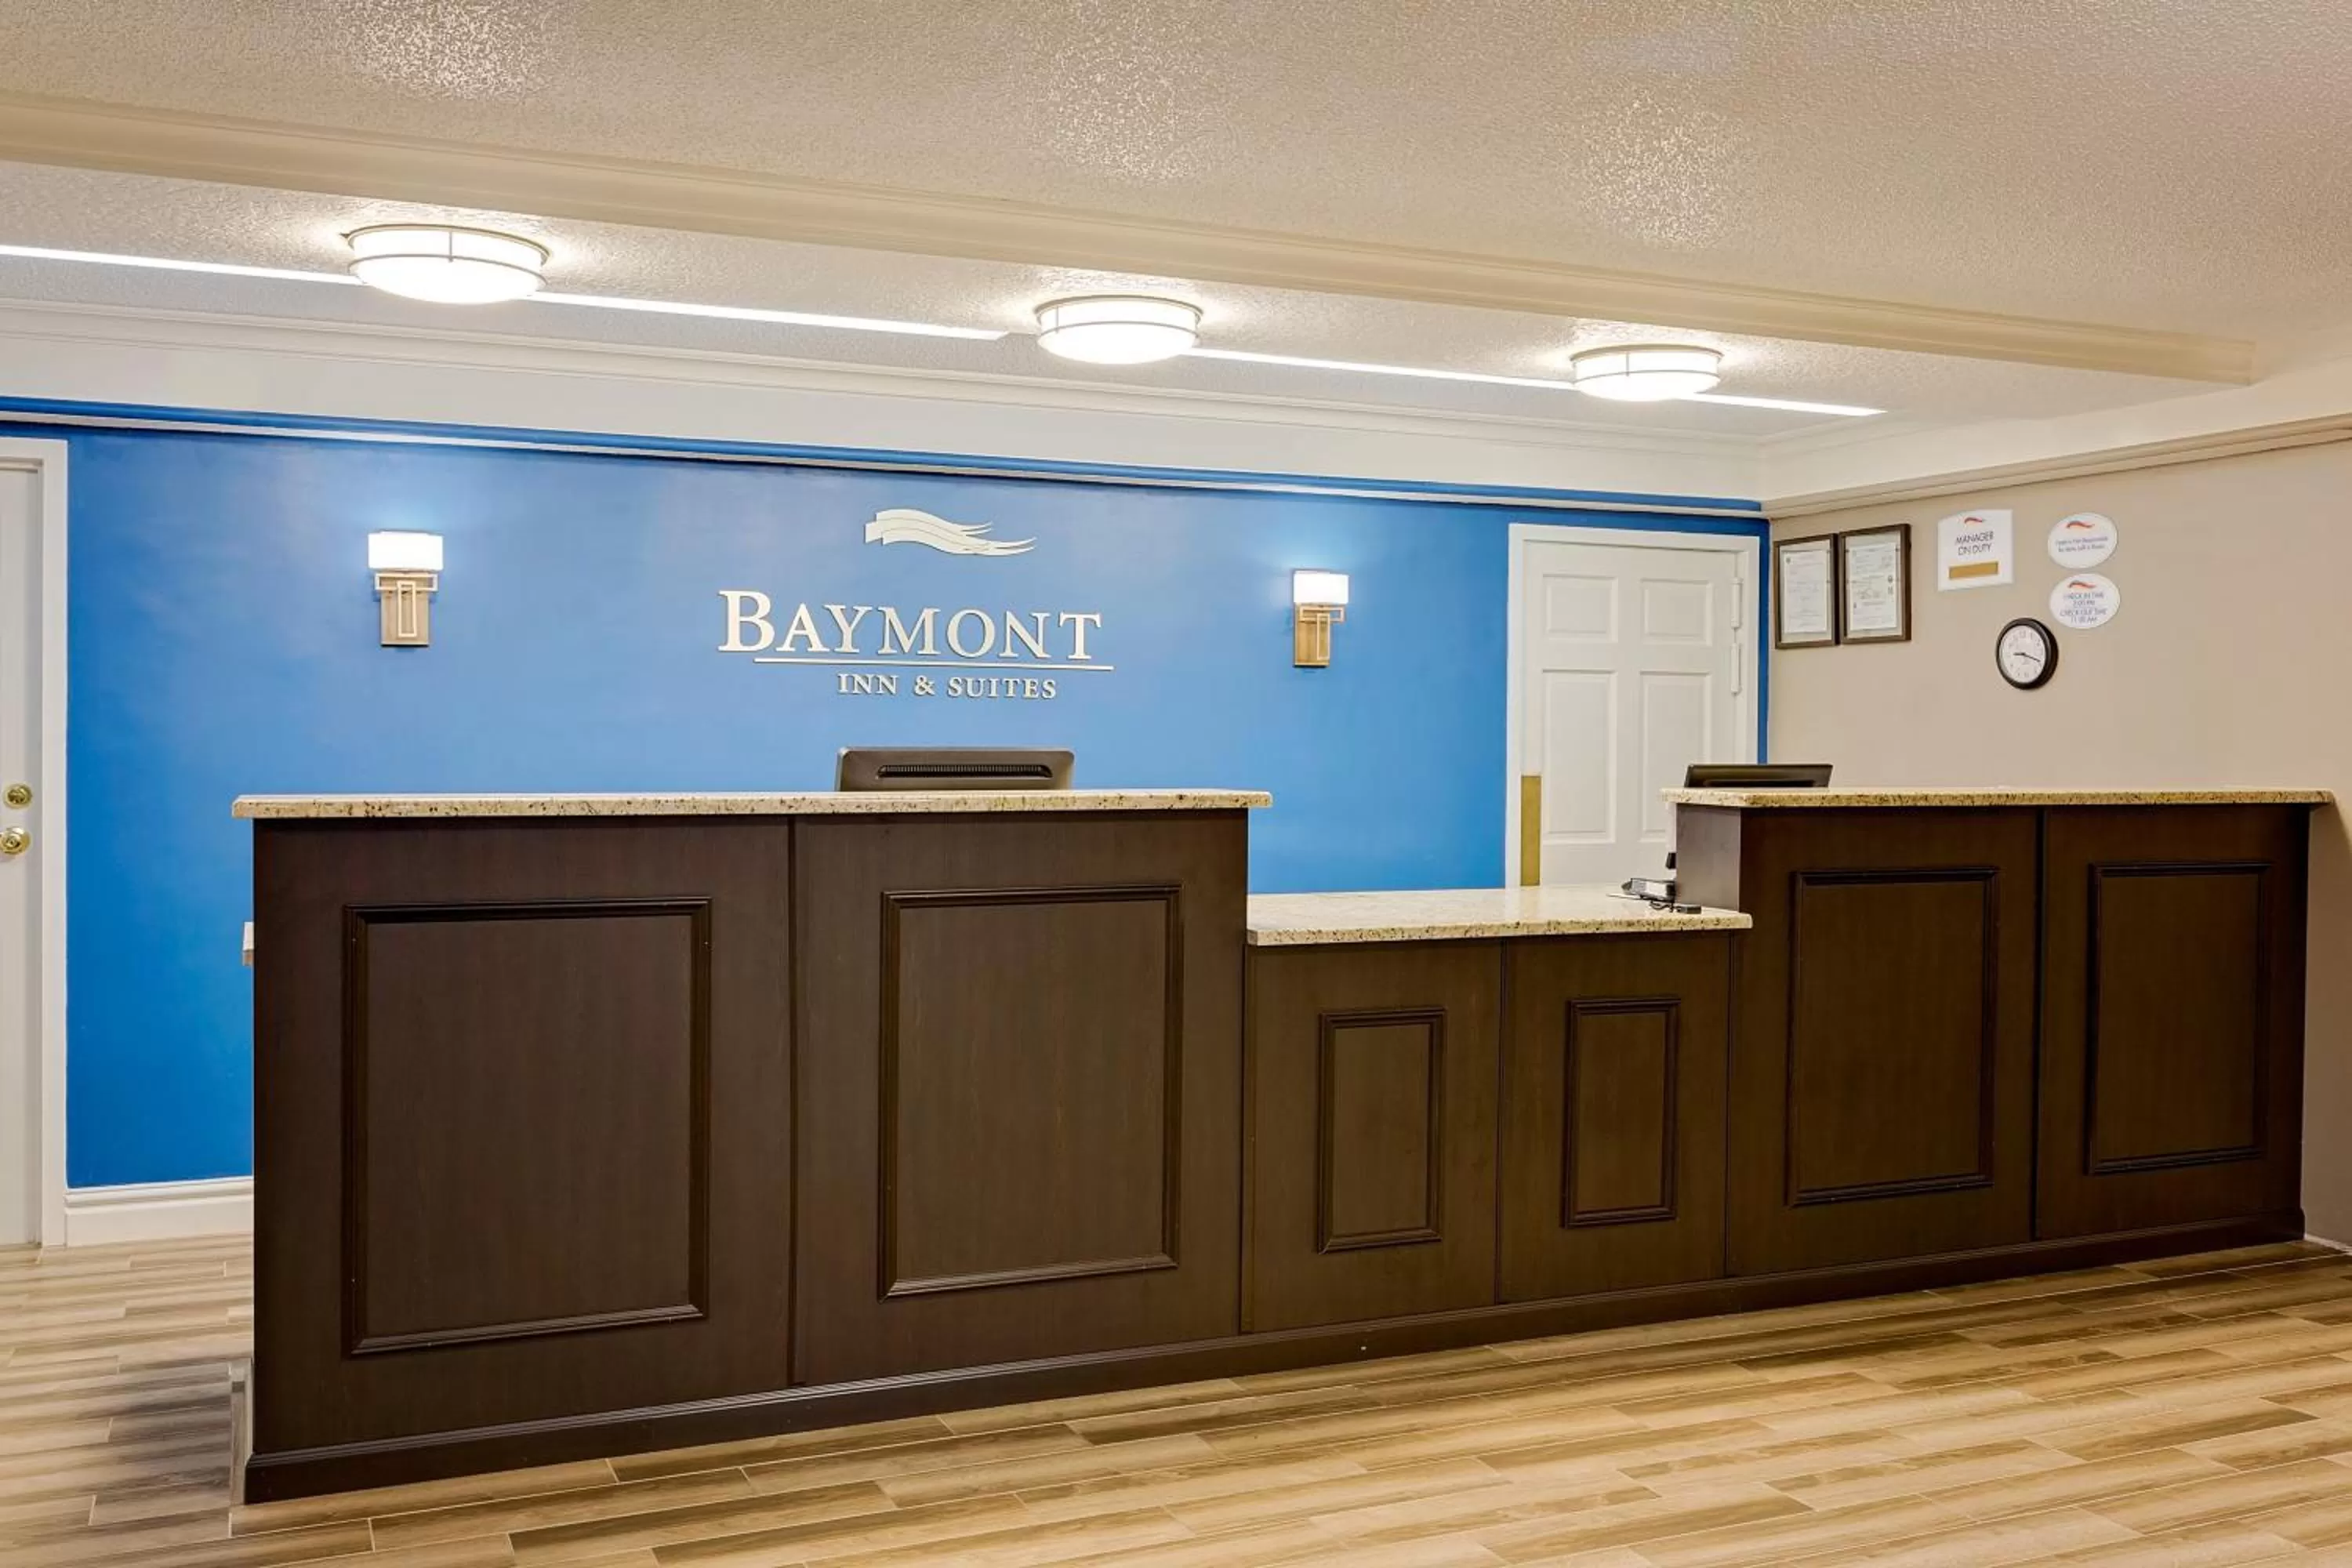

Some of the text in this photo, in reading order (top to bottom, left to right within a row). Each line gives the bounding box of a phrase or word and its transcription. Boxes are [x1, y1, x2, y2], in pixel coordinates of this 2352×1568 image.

[1955, 531, 1993, 545] MANAGER
[1958, 543, 1993, 556] ON DUTY
[717, 590, 1102, 661] BAYMONT
[837, 673, 1057, 699] INN & SUITES
